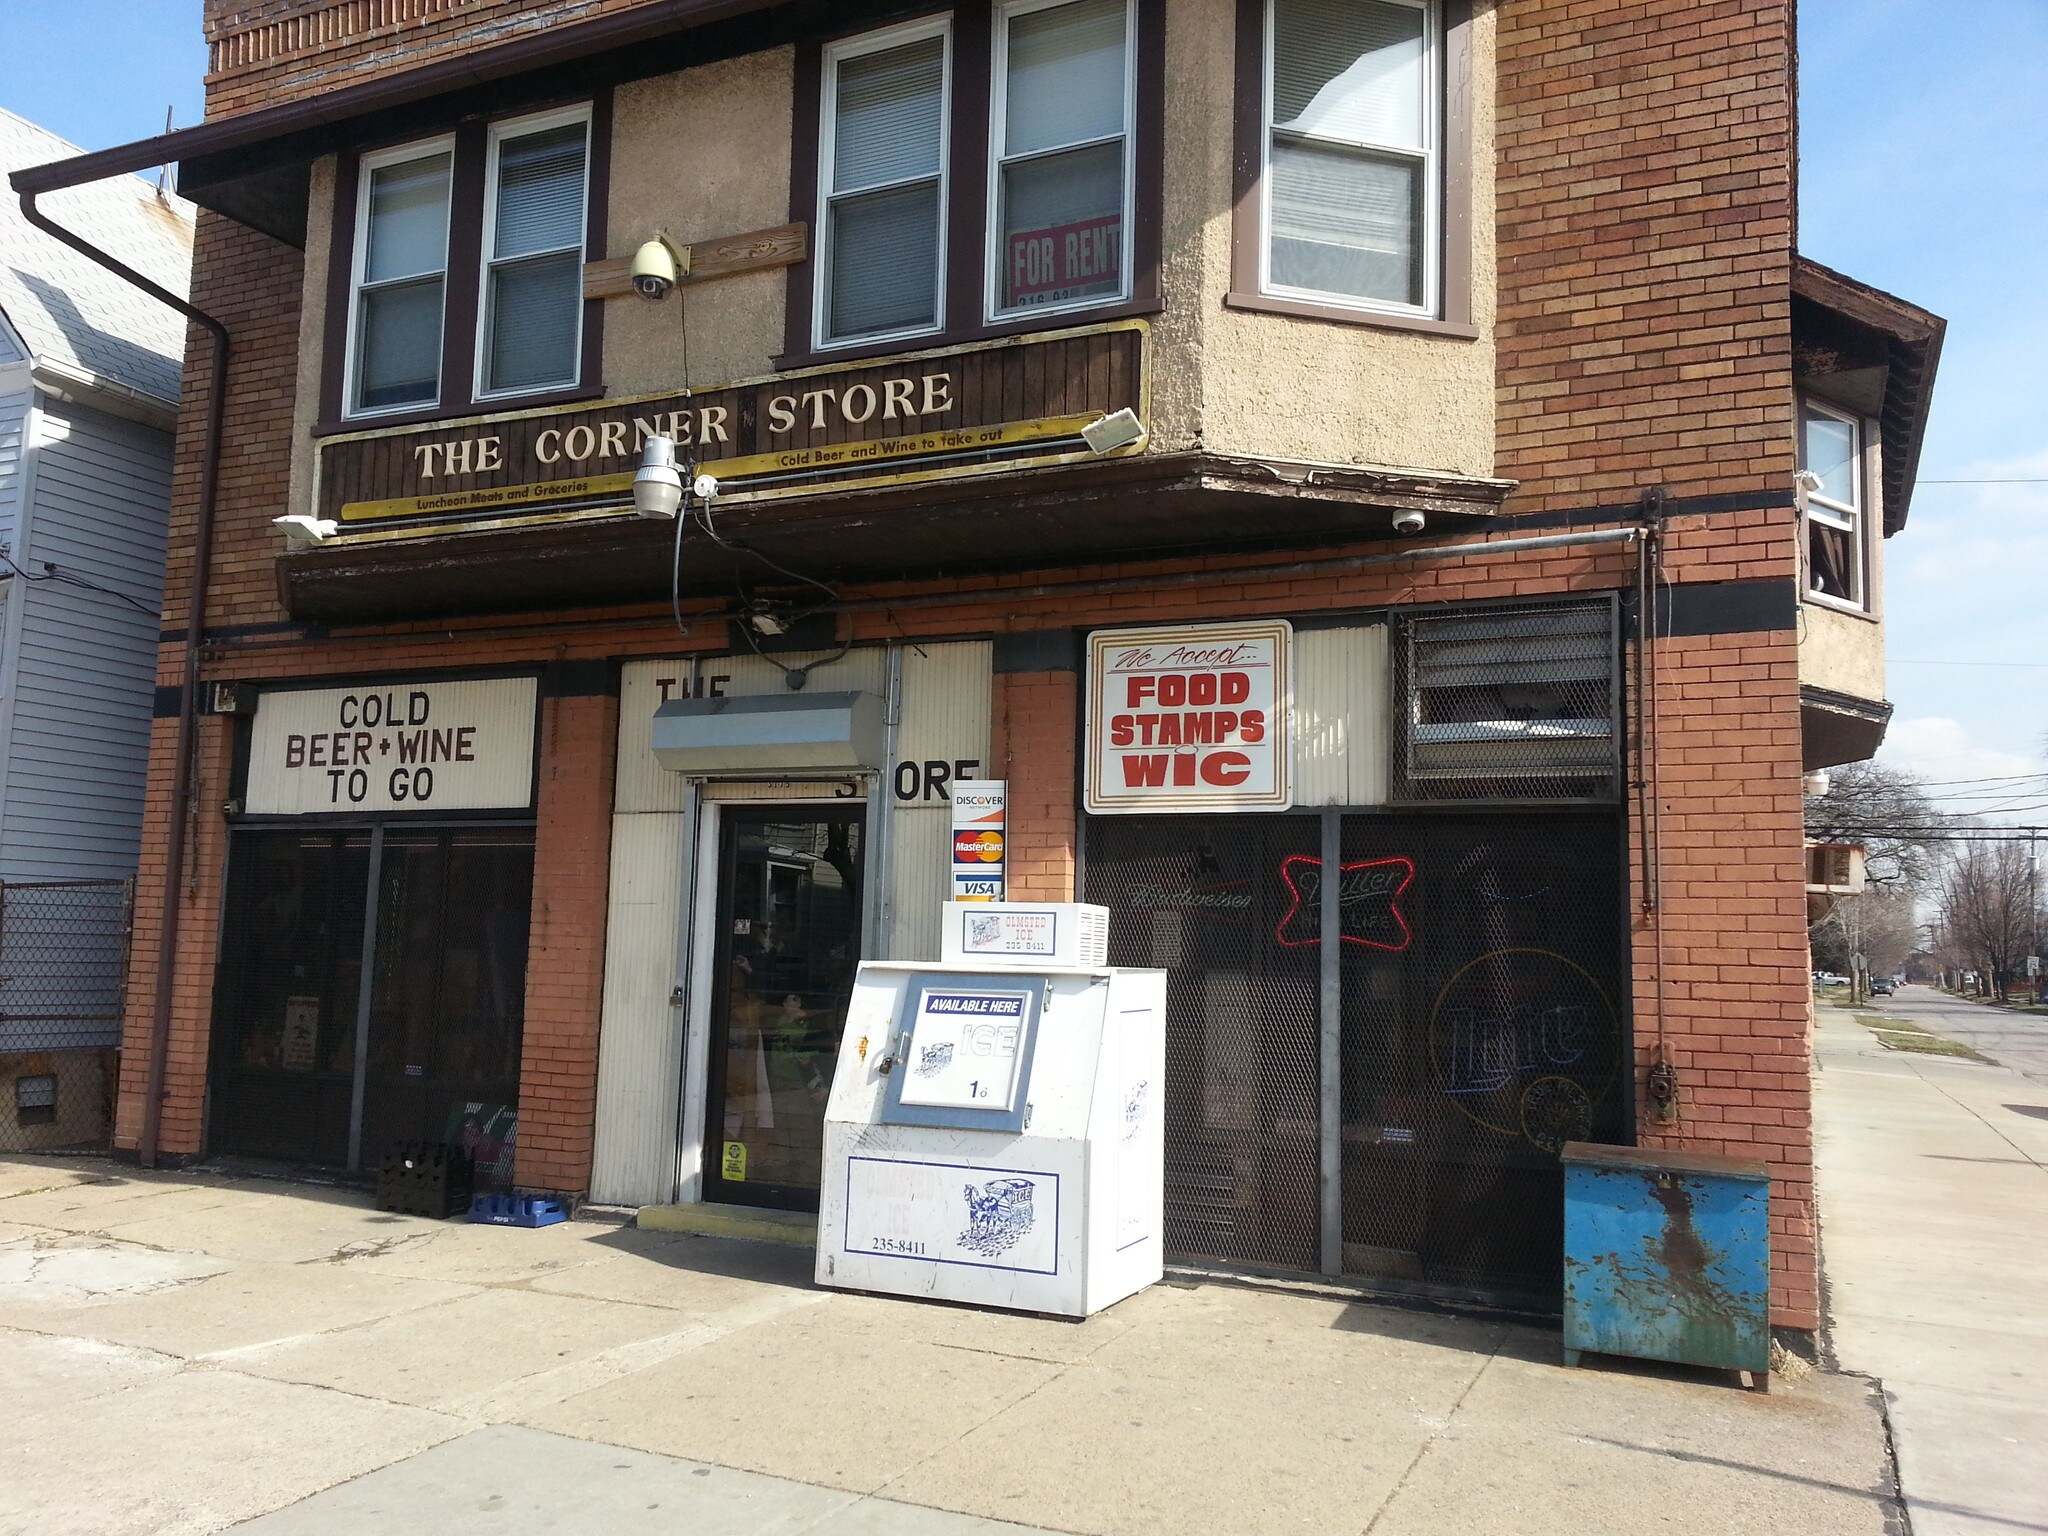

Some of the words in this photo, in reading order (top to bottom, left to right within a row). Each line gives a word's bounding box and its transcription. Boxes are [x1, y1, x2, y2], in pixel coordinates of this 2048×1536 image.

[1014, 237, 1055, 287] FOR
[1065, 223, 1120, 280] RENT
[414, 436, 503, 478] THE
[535, 406, 729, 464] CORNER
[767, 372, 954, 435] STORE
[780, 451, 809, 467] Cold
[815, 450, 845, 462] Beer
[850, 444, 877, 458] and
[880, 440, 916, 454] Wine
[922, 437, 935, 449] to
[940, 434, 973, 447] take
[979, 428, 1003, 441] out
[417, 495, 467, 510] Luncheon
[469, 491, 504, 504] Meats
[507, 486, 529, 499] and
[534, 481, 588, 496] Groceries
[1114, 647, 1157, 668] We
[1127, 672, 1250, 708] FOOD
[340, 691, 430, 728] COLD
[1111, 710, 1265, 746] STAMPS
[285, 731, 373, 769] BEER
[397, 727, 477, 764] WINE
[327, 768, 368, 803] TO
[389, 767, 433, 802] GO
[1122, 751, 1252, 787] WIC
[956, 796, 1003, 805] DISCOVER
[955, 842, 1003, 852] MasterCard
[964, 882, 995, 895] VISA
[1006, 916, 1046, 928] OLMSTED
[1016, 929, 1033, 940] ICE
[929, 999, 987, 1013] AVAILABLE
[990, 1000, 1020, 1014] HERE
[959, 1023, 1019, 1058] ICE
[1013, 1187, 1032, 1204] ICE
[872, 1237, 926, 1255] 235-8411
